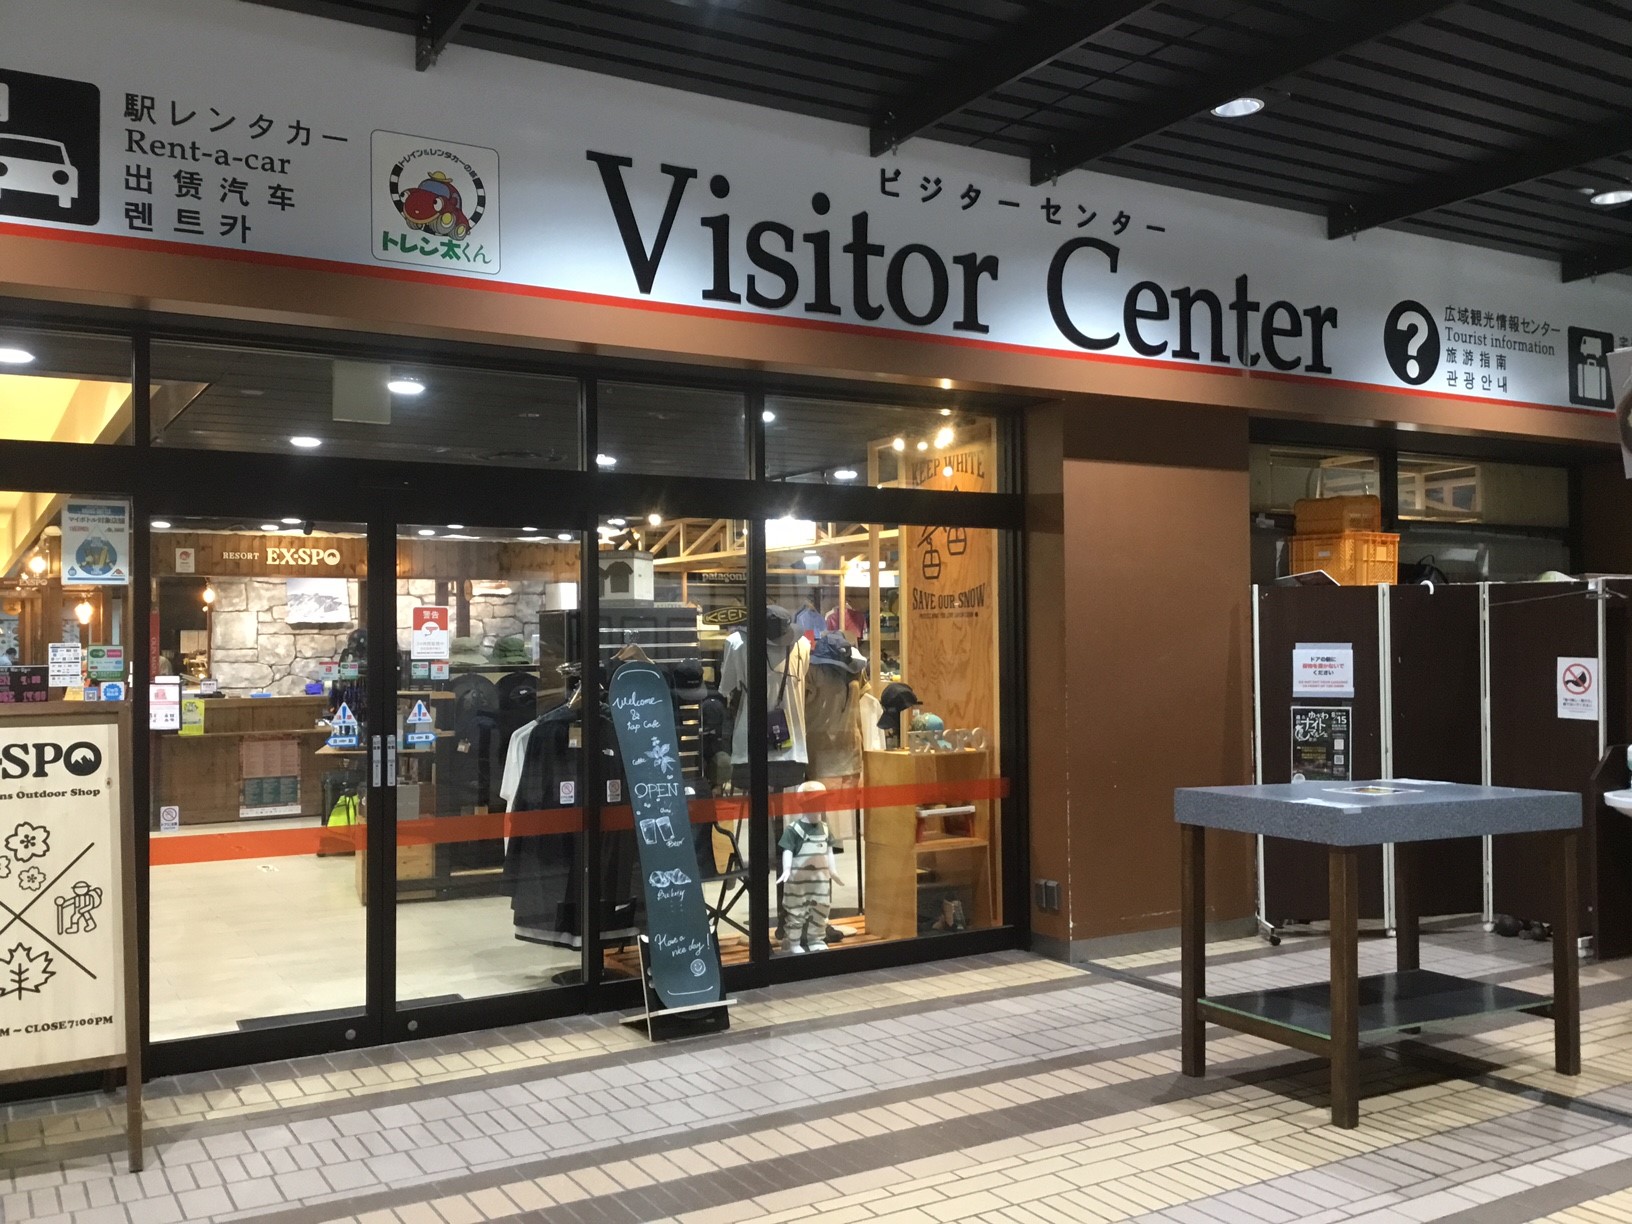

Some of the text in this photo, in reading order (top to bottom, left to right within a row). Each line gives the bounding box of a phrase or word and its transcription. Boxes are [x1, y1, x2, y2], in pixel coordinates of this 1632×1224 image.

[124, 92, 349, 147] 駅レンタカー
[125, 128, 291, 175] Rent-a-car
[880, 167, 1166, 237] ビジターセンター
[124, 201, 252, 244] 렌트카
[382, 230, 492, 264] トレン太くん
[585, 149, 1338, 375] Visitor Center
[1444, 304, 1561, 338] 広域観光情報センター
[1445, 326, 1556, 356] Tourist information
[1445, 346, 1508, 371] 旅游指南
[1446, 370, 1508, 394] 관광안내
[912, 449, 985, 487] KEEP WHITE
[222, 551, 260, 560] RESORT
[702, 572, 747, 583] patagoni
[912, 582, 986, 611] SAVE OUR SNOW
[612, 691, 663, 709] Welcome
[1300, 717, 1326, 733] ナイト
[16, 789, 68, 799] Outdoor
[70, 788, 101, 797] Shop
[634, 782, 679, 799] OPEN
